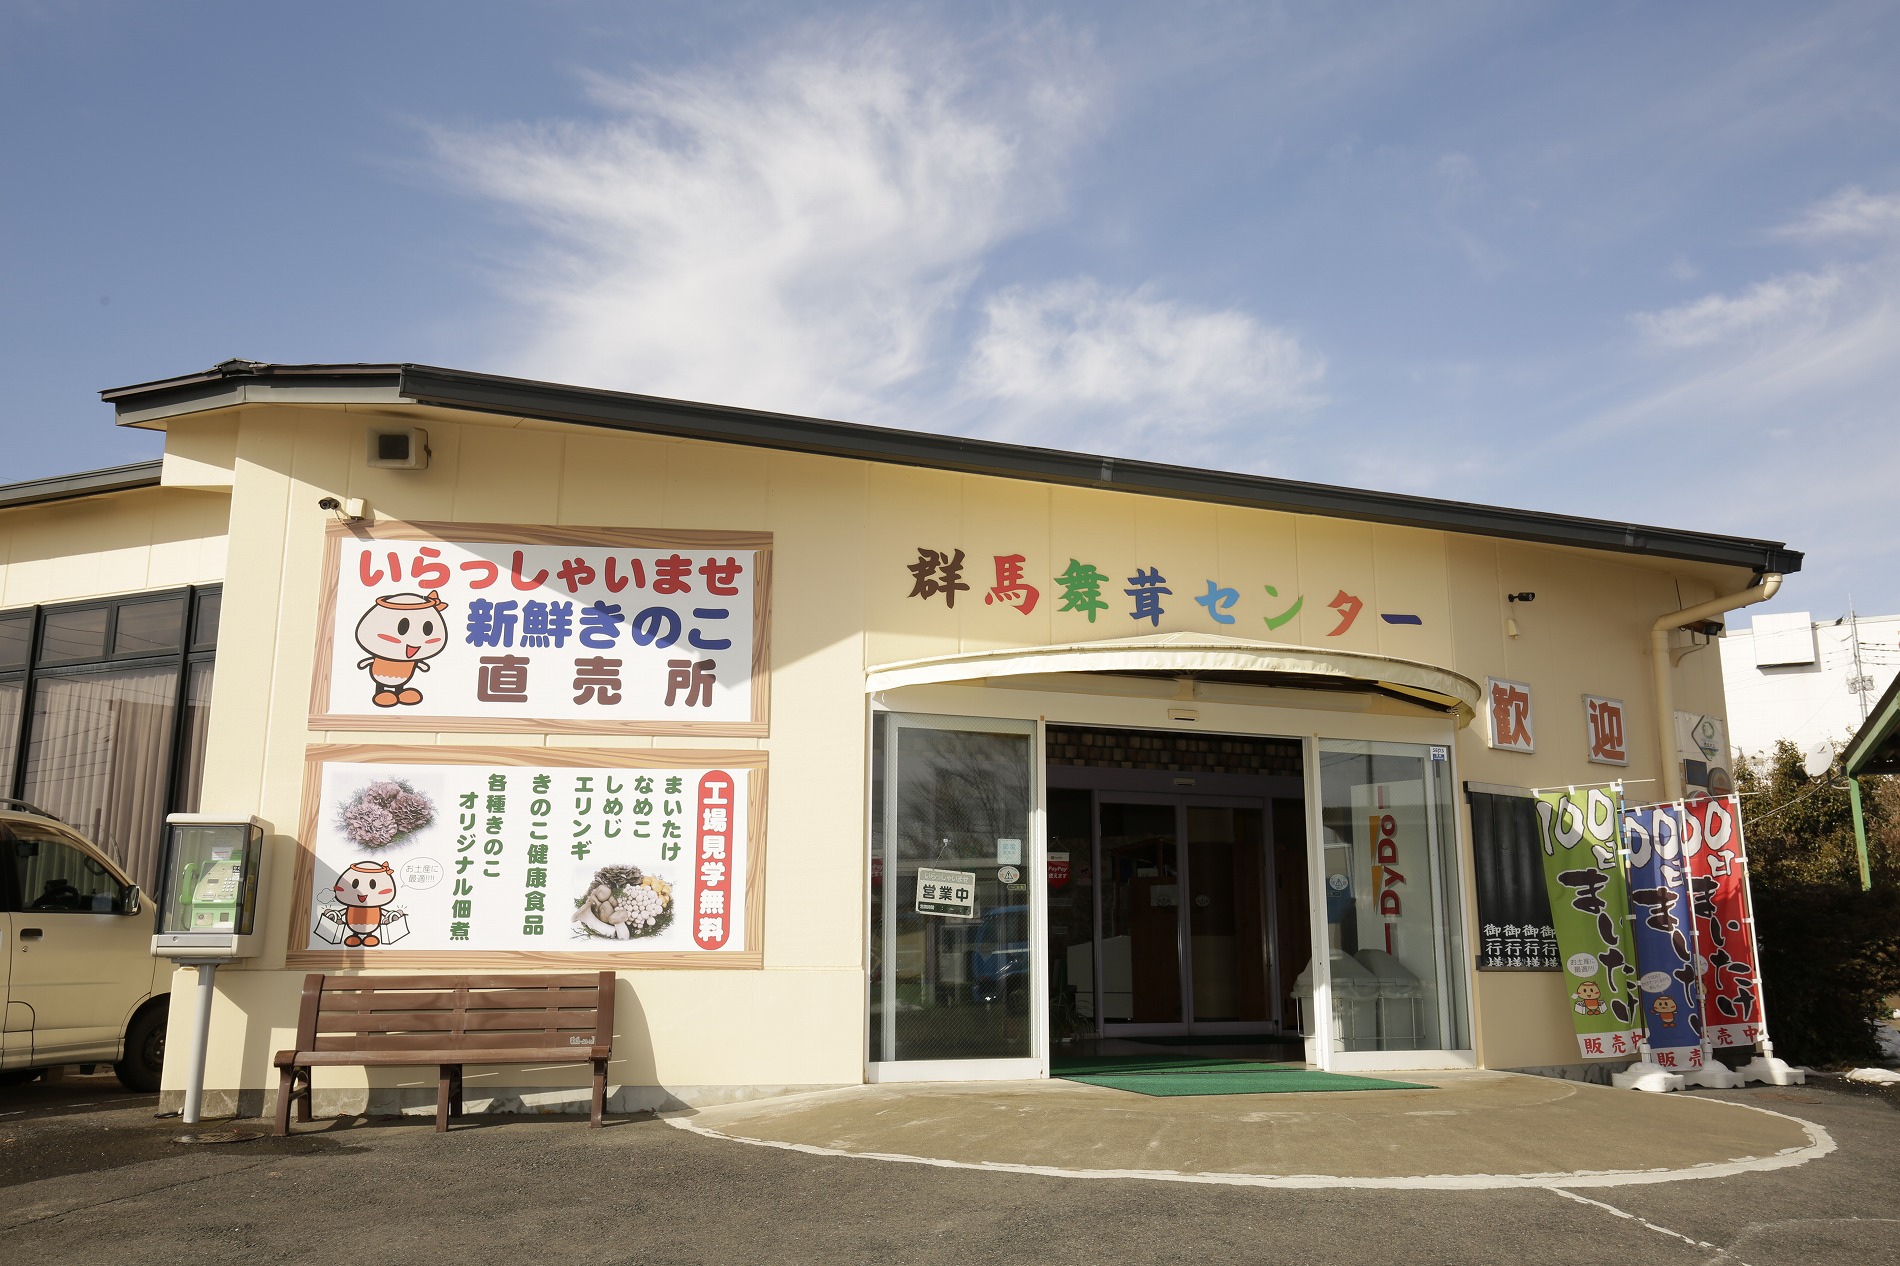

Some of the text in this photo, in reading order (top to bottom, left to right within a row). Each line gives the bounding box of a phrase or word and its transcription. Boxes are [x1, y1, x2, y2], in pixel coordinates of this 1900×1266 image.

[359, 547, 743, 596] いらっしゃいませ
[907, 547, 1422, 636] 群馬舞茸センター
[466, 598, 732, 651] 新鮮きのこ
[477, 654, 716, 708] 直売所
[1491, 682, 1626, 761] 歓 迎
[483, 773, 508, 879] 各種きのこ
[570, 775, 595, 861] エリンギ
[602, 775, 624, 839] しめじ
[632, 775, 655, 839] なめこ
[661, 775, 684, 862] まいたけ
[405, 864, 439, 874] お土産に
[449, 791, 480, 942] オリジナル佃煮
[522, 773, 552, 937] きのこ健康食品
[697, 780, 730, 943] 工場見学無料
[924, 872, 970, 883] いらっしゃいませ
[922, 883, 969, 902] 営業中
